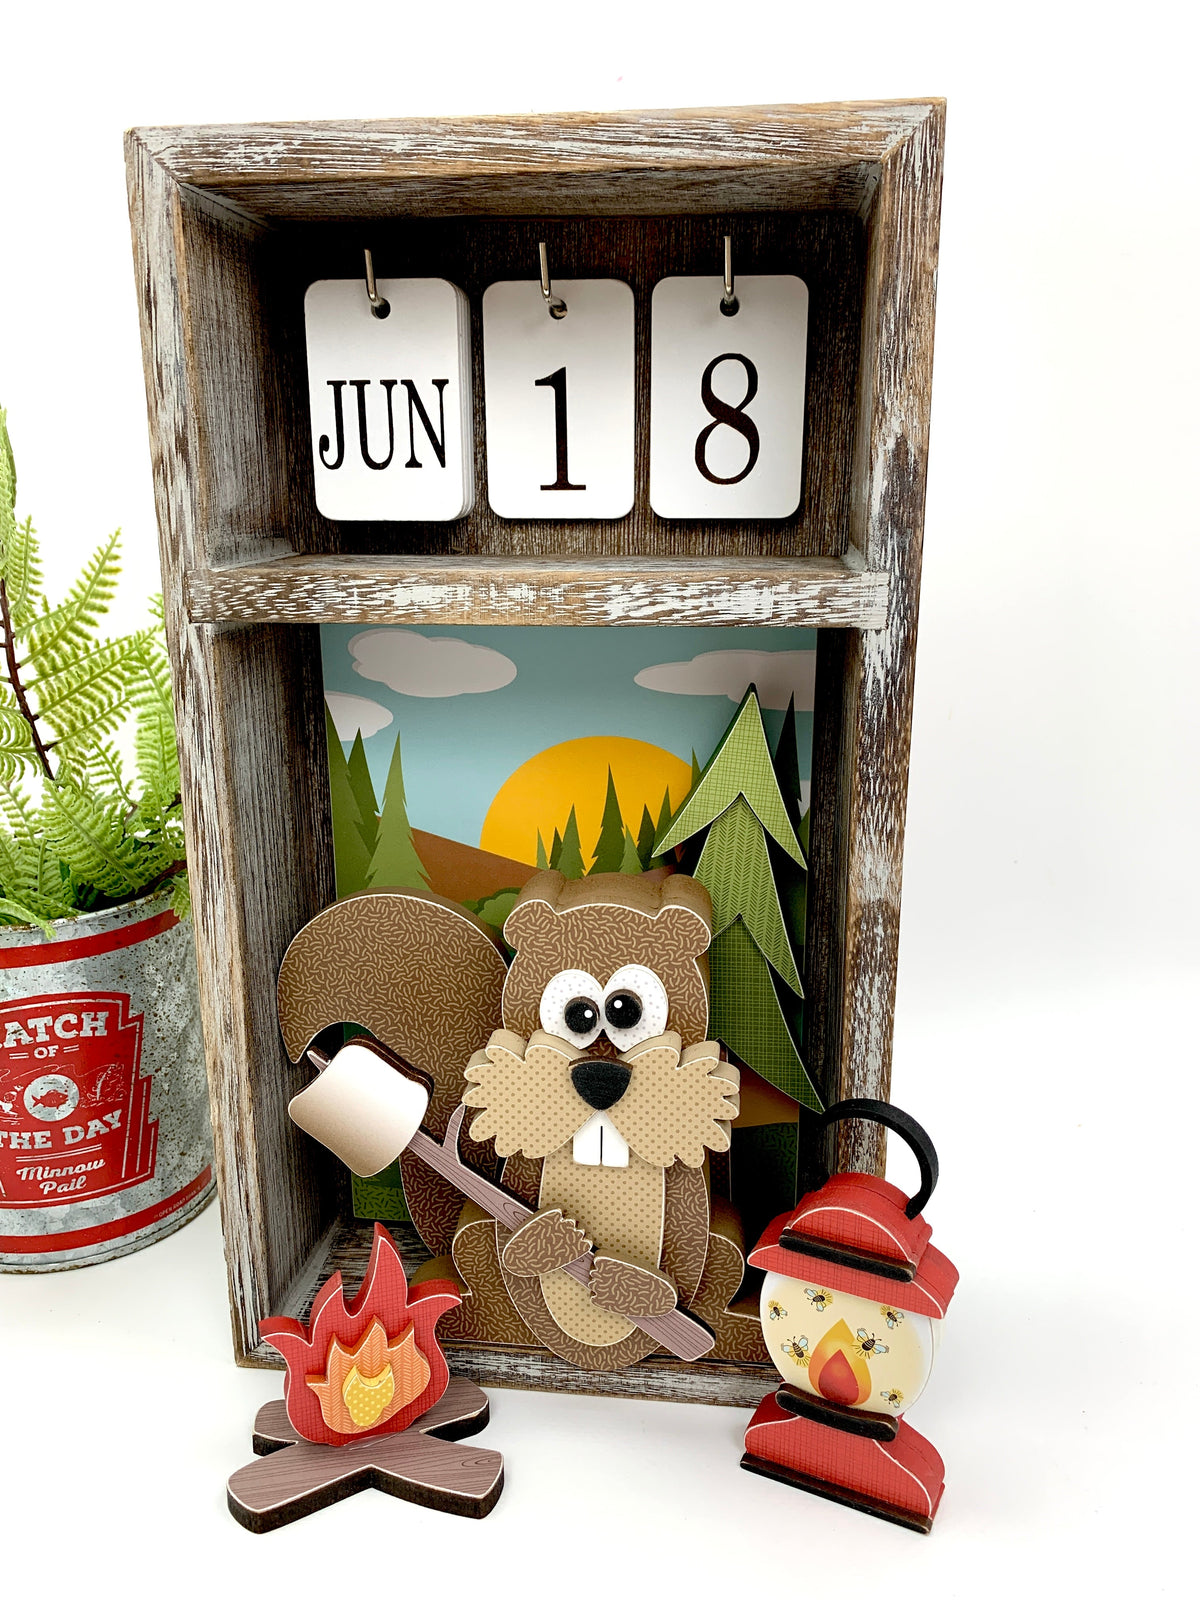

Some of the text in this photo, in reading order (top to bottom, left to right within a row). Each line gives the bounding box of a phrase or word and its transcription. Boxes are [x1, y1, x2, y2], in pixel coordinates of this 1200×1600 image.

[319, 352, 760, 491] JUN 1 8
[0, 1011, 109, 1048] ATCH
[33, 1045, 59, 1059] OF
[62, 1109, 122, 1145] DAY
[16, 1159, 106, 1181] Minnow
[39, 1175, 87, 1195] Pail
